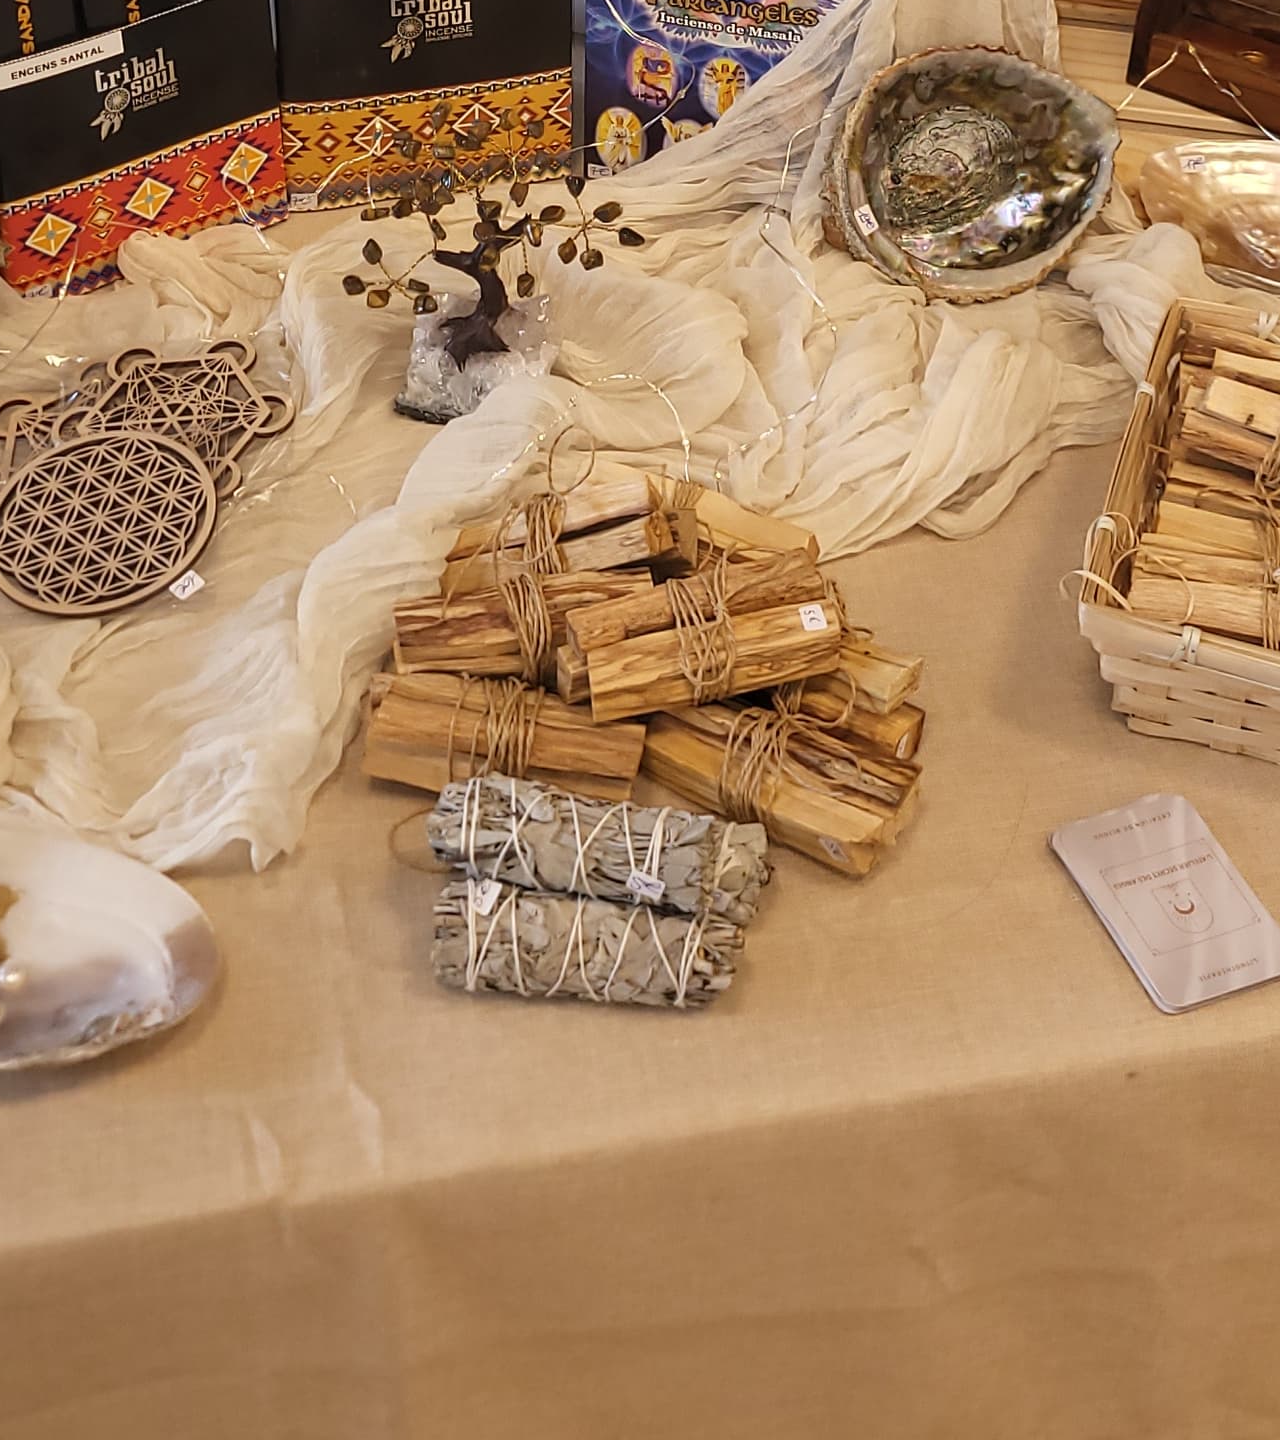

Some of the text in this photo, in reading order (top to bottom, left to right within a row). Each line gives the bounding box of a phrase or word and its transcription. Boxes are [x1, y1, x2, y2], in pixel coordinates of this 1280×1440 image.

[425, 1, 473, 29] soul
[425, 24, 473, 37] INCENSE
[659, 11, 802, 43] Incienso de Masala
[11, 46, 104, 80] ENCENS SANTAL
[94, 48, 167, 92] tribal
[130, 60, 179, 97] soul
[132, 83, 180, 106] INCENSE
